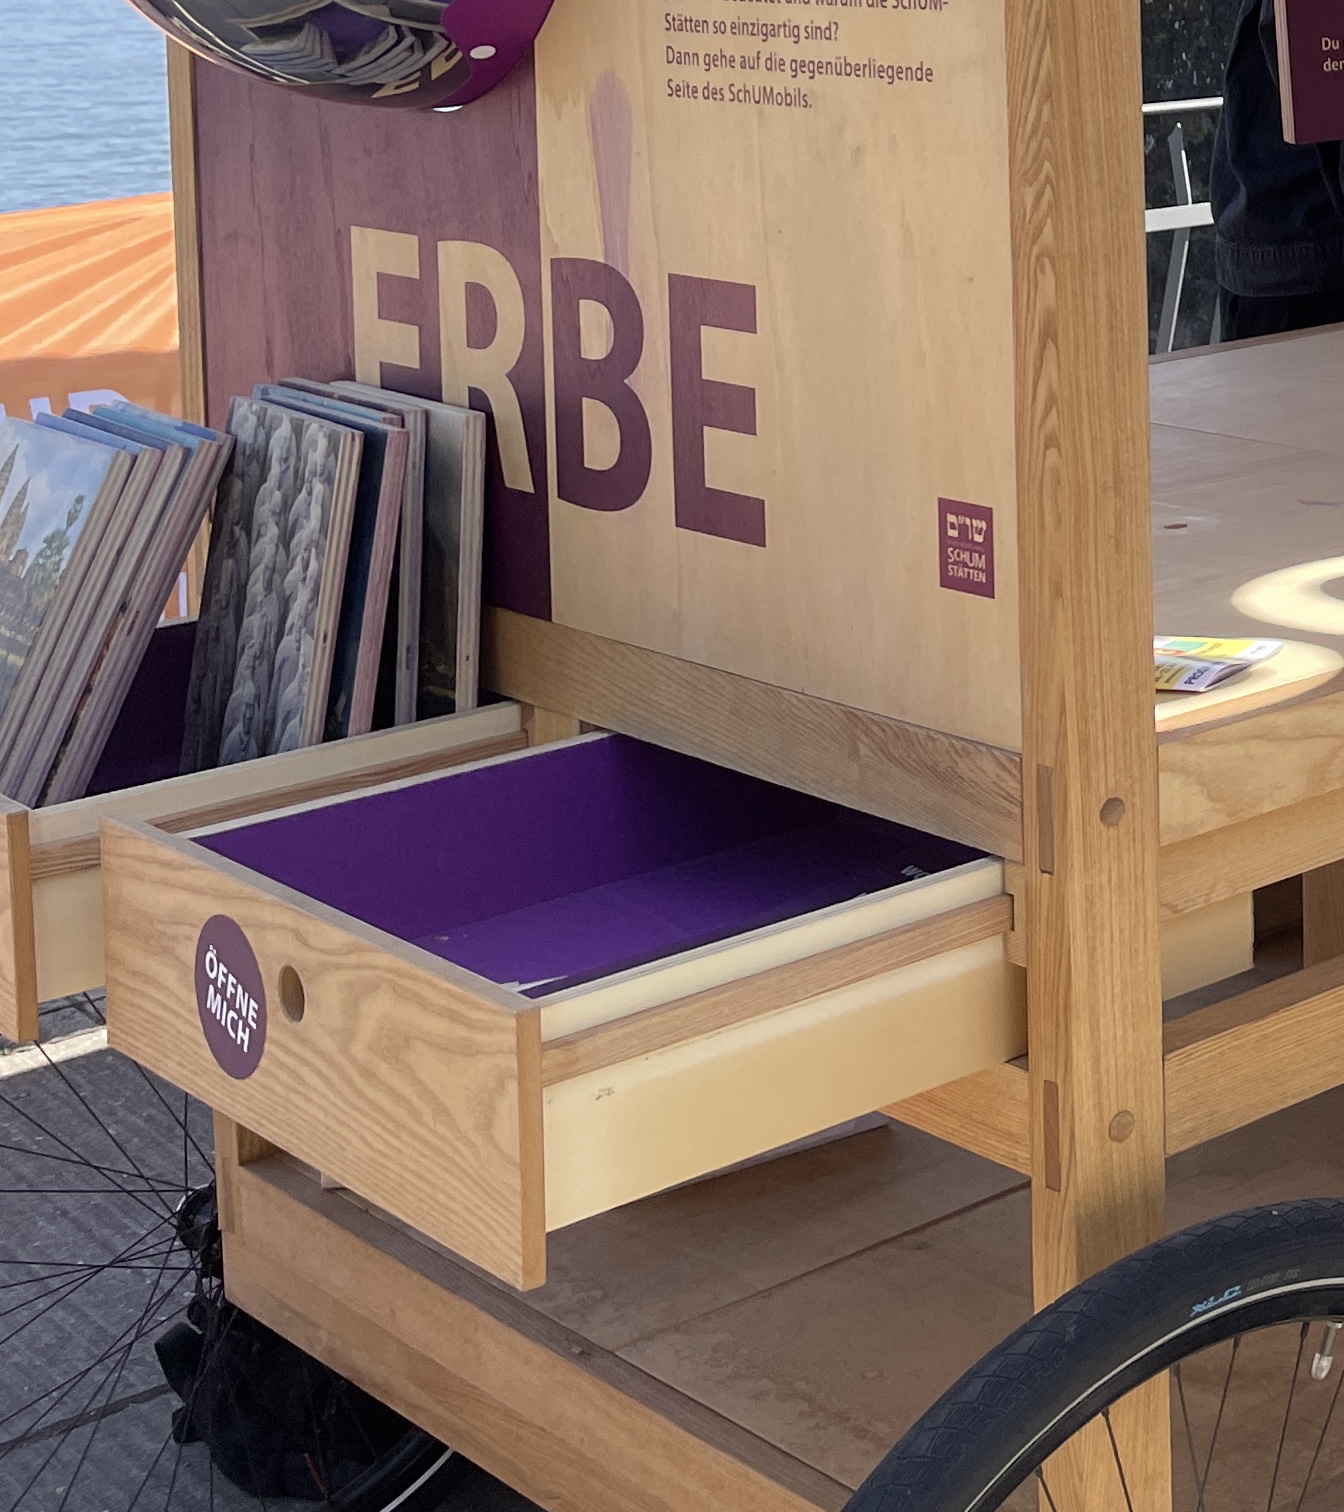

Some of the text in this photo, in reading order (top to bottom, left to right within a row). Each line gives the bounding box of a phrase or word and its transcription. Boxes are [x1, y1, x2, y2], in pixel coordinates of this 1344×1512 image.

[664, 11, 839, 45] Stätten so einzigartig sind?
[1321, 36, 1340, 51] Du
[666, 77, 813, 109] Seite des SchUMobils.
[350, 225, 767, 548] ERBE
[947, 547, 986, 569] SCHUM
[947, 564, 987, 584] STÄTTEN
[204, 944, 259, 1030] ÖFFNE
[206, 984, 250, 1053] MICH
